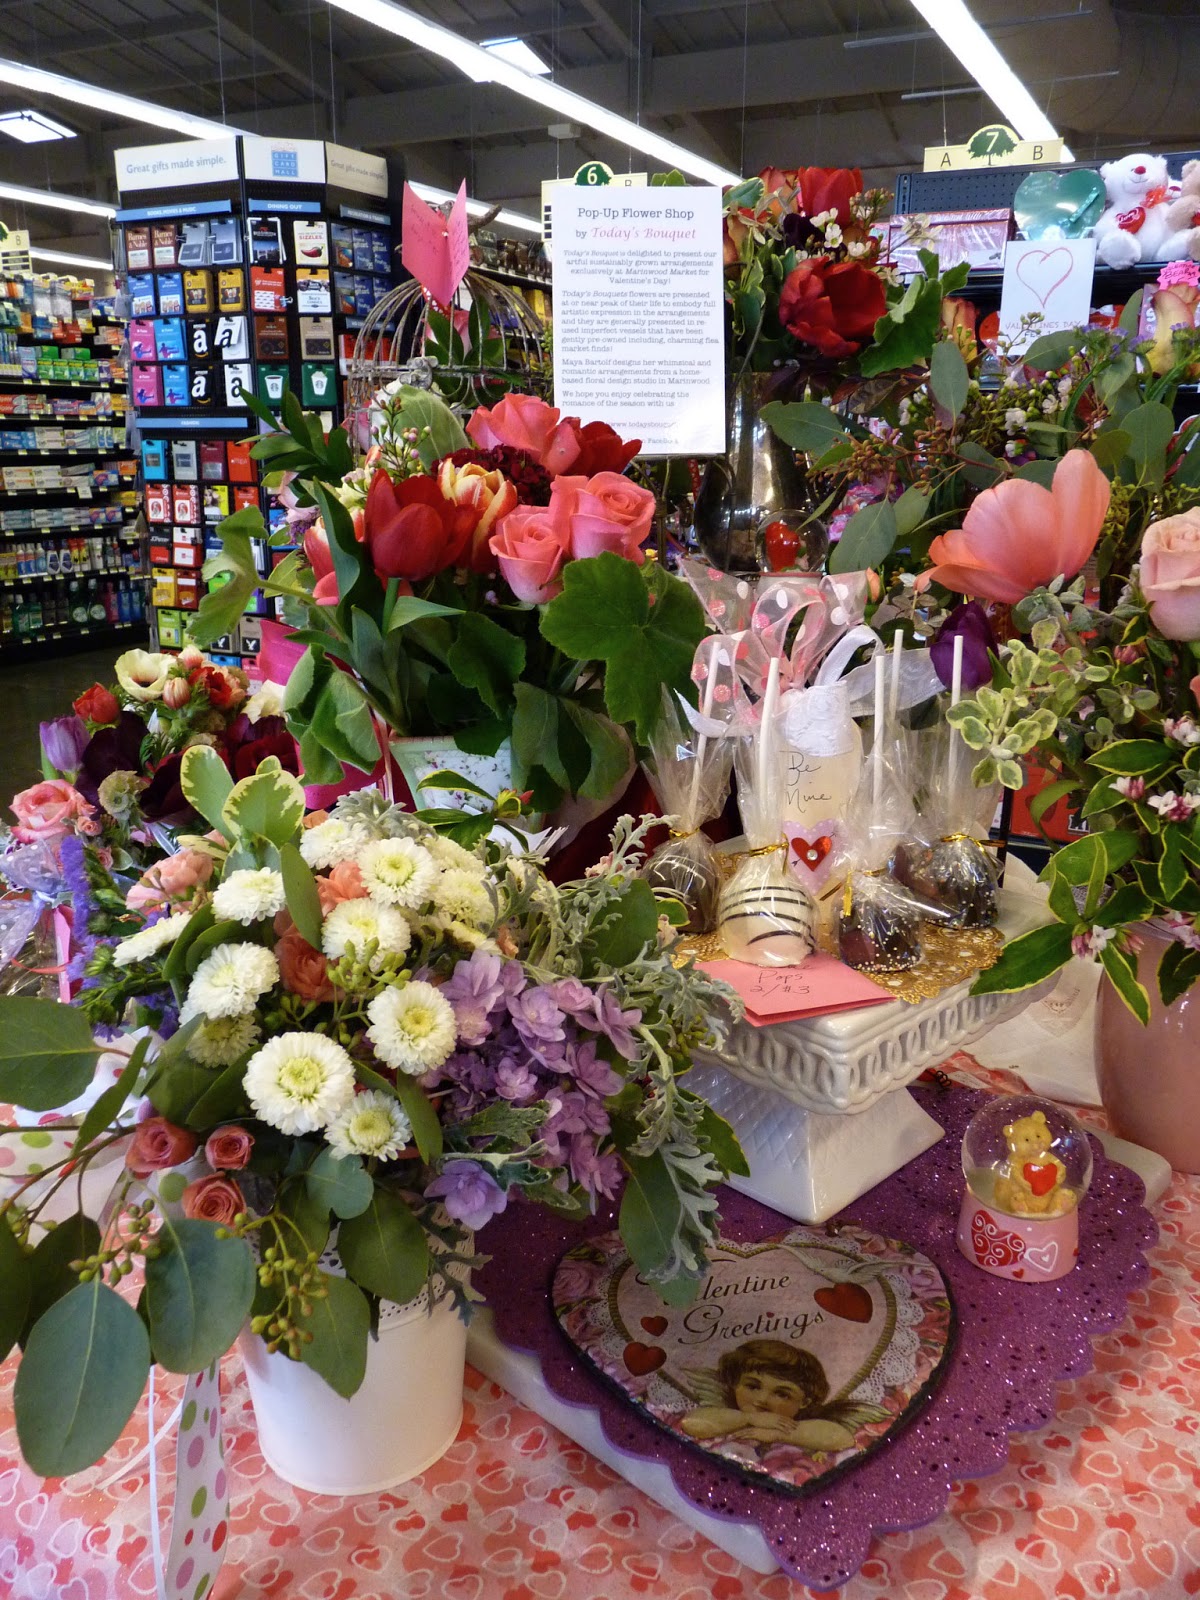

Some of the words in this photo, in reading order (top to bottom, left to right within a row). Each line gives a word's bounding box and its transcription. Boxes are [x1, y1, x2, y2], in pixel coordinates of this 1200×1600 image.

[986, 131, 999, 152] 7
[941, 152, 952, 167] A
[1033, 145, 1044, 161] B
[127, 164, 150, 174] Great
[152, 160, 169, 174] gifts
[171, 158, 194, 169] made
[196, 155, 227, 169] simple.
[587, 166, 598, 186] 6
[578, 208, 619, 220] Pop-Up
[622, 208, 662, 218] Flower
[665, 209, 694, 220] Shop
[576, 229, 587, 239] by
[591, 227, 639, 241] Today's
[644, 228, 696, 241] Bouquet
[627, 250, 662, 258] delighted
[590, 259, 633, 267] sustainably
[578, 318, 595, 326] they
[581, 327, 617, 335] imperfect
[561, 336, 586, 344] gently
[612, 359, 641, 367] designs
[607, 377, 632, 385] design
[611, 391, 631, 399] enjoy
[633, 391, 675, 399] celebrating
[779, 750, 821, 786] Be
[758, 969, 803, 984] Pops
[677, 1304, 825, 1345] Greetings
